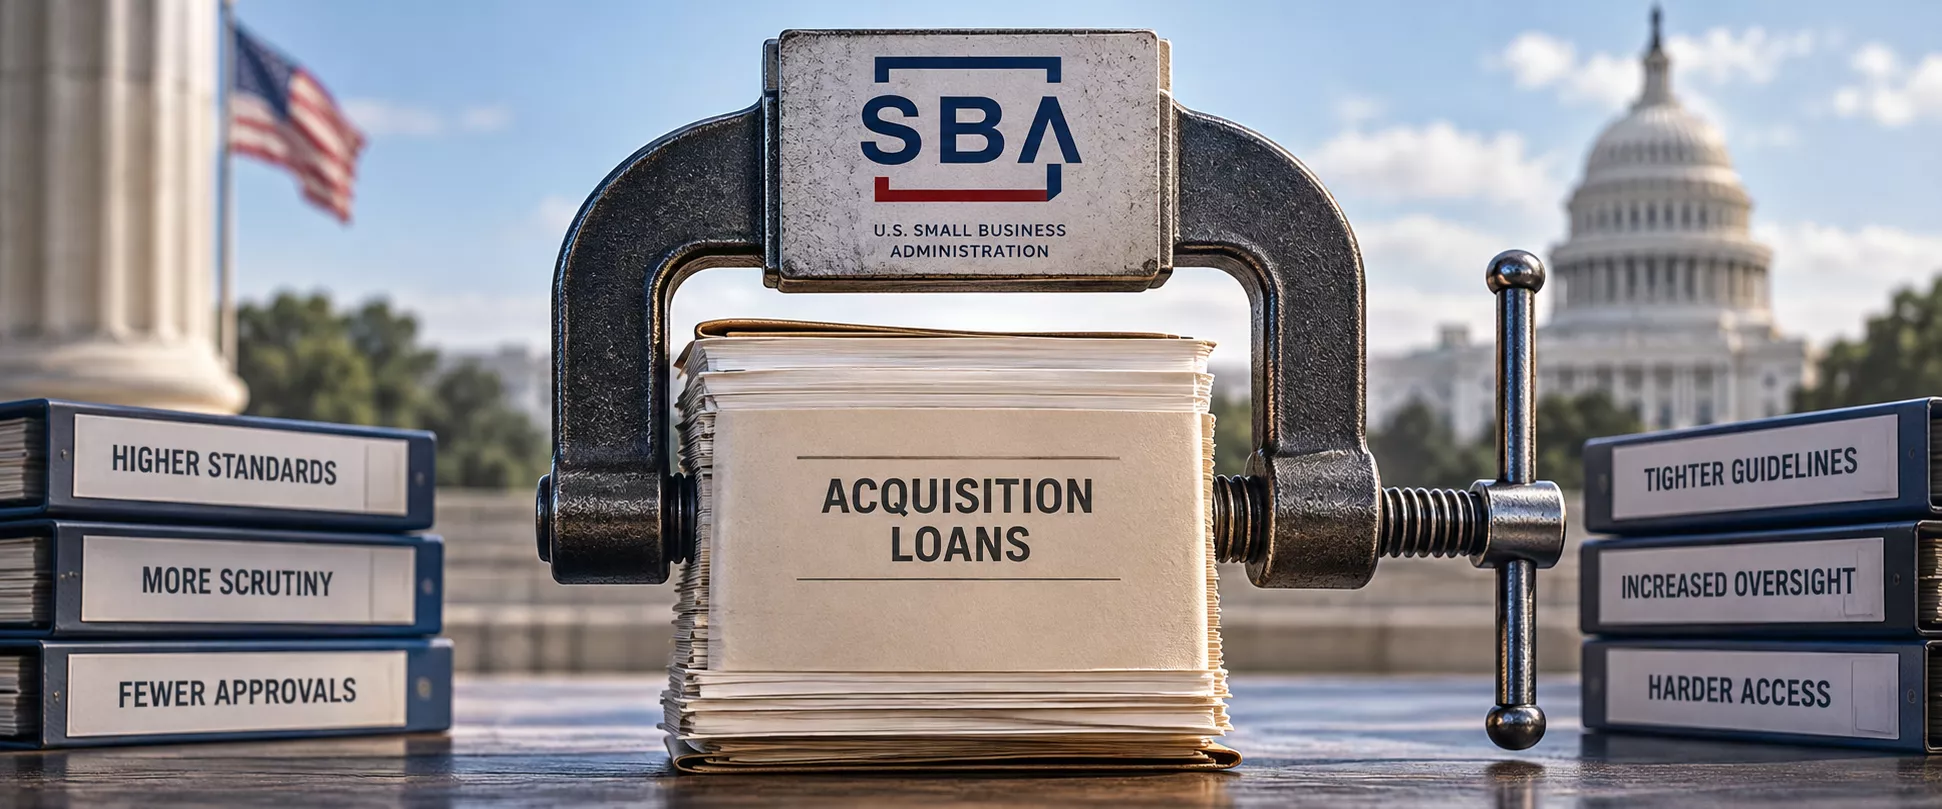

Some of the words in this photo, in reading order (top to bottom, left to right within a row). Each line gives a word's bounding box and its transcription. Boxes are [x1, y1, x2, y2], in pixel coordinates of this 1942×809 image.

[861, 95, 1082, 165] SBA
[875, 224, 907, 237] U.S.
[914, 224, 972, 237] SMALL
[979, 224, 1066, 237] BUSINESS
[890, 245, 1048, 258] ADMINISTRATION
[113, 445, 199, 476] HIGHER
[208, 452, 336, 485] STANDARDS
[1644, 461, 1724, 491] TIGHTER
[1732, 447, 1857, 484] GUIDELINES
[822, 478, 1092, 517] ACQUISITION
[892, 526, 1030, 562] LOANS
[143, 566, 211, 594] MORE
[220, 568, 333, 596] SCRUTINY
[1622, 572, 1727, 599] INCREASED
[1735, 567, 1856, 596] OVERSIGHT
[119, 681, 205, 708] FEWER
[214, 678, 356, 705] APPROVALS
[1649, 674, 1733, 703] HARDER
[1741, 678, 1831, 708] ACCESS
